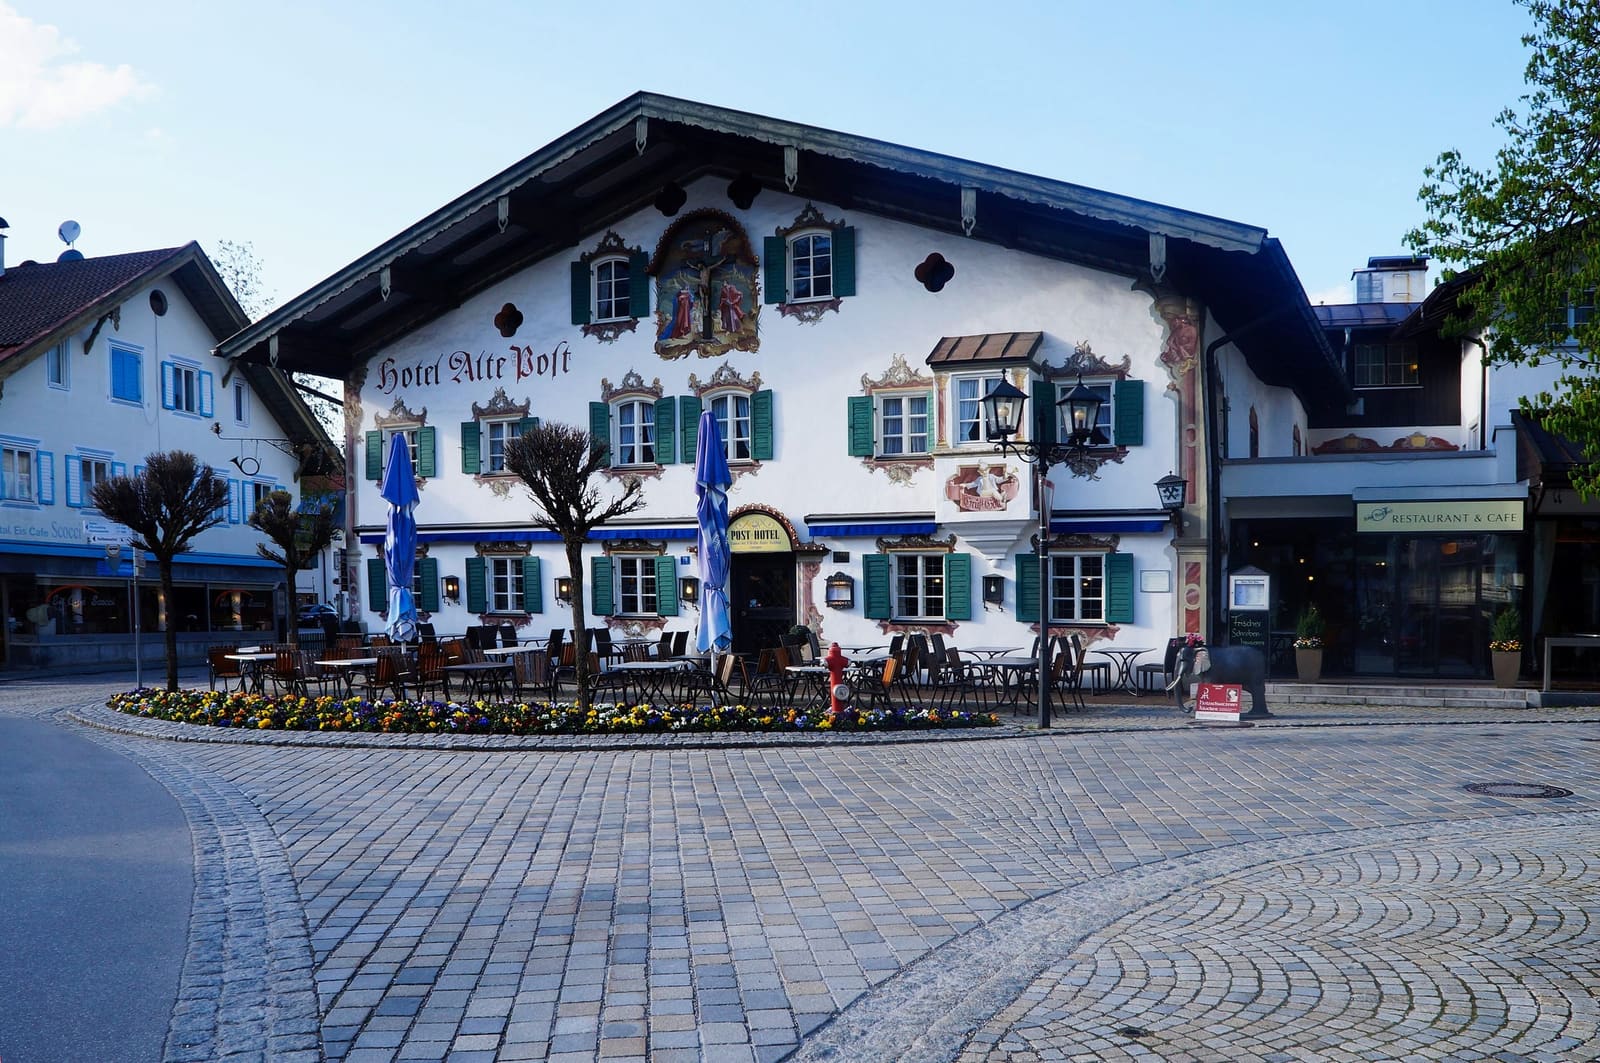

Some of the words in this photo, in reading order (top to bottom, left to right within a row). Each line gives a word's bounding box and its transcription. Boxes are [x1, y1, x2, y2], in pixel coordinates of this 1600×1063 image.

[374, 353, 444, 395] Hotel
[448, 349, 507, 384] Alte
[1392, 513, 1470, 523] RESTAURANT
[1474, 514, 1482, 523] &
[1487, 513, 1517, 522] CAFE
[730, 530, 750, 540] POST
[754, 529, 780, 540] HOTEL
